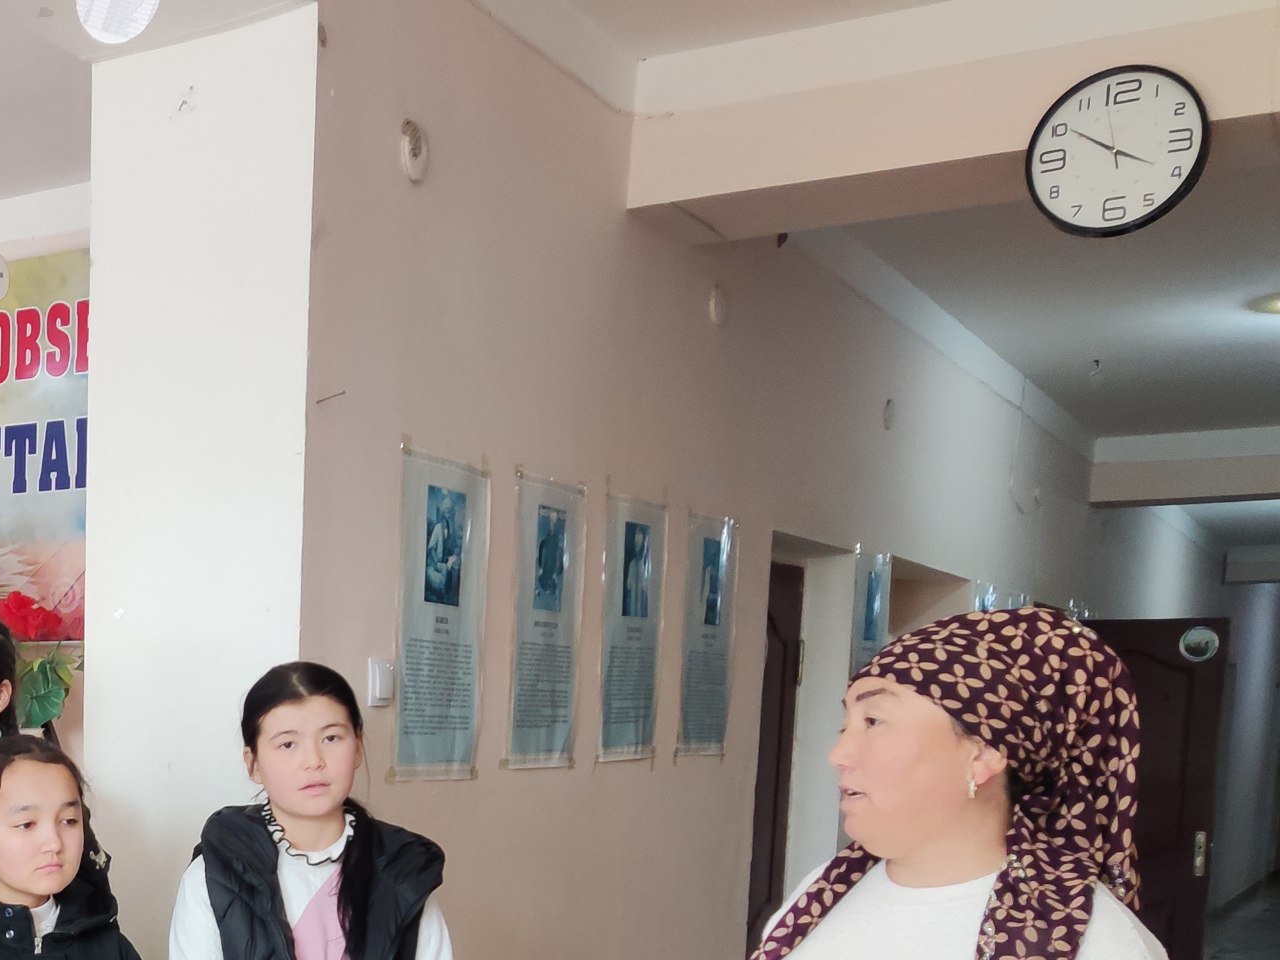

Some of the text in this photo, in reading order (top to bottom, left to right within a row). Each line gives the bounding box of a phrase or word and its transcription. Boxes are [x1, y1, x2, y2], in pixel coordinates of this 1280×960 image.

[1105, 78, 1142, 107] 12
[1155, 84, 1160, 98] 1
[1078, 96, 1091, 112] 11
[1173, 102, 1186, 116] 2
[1051, 122, 1068, 138] 10
[1167, 127, 1193, 153] 3
[1039, 148, 1067, 174] 9
[1170, 165, 1182, 179] 4
[1049, 184, 1060, 199] 8
[1142, 192, 1155, 207] 5
[1070, 204, 1083, 218] 7
[1102, 195, 1127, 221] 6
